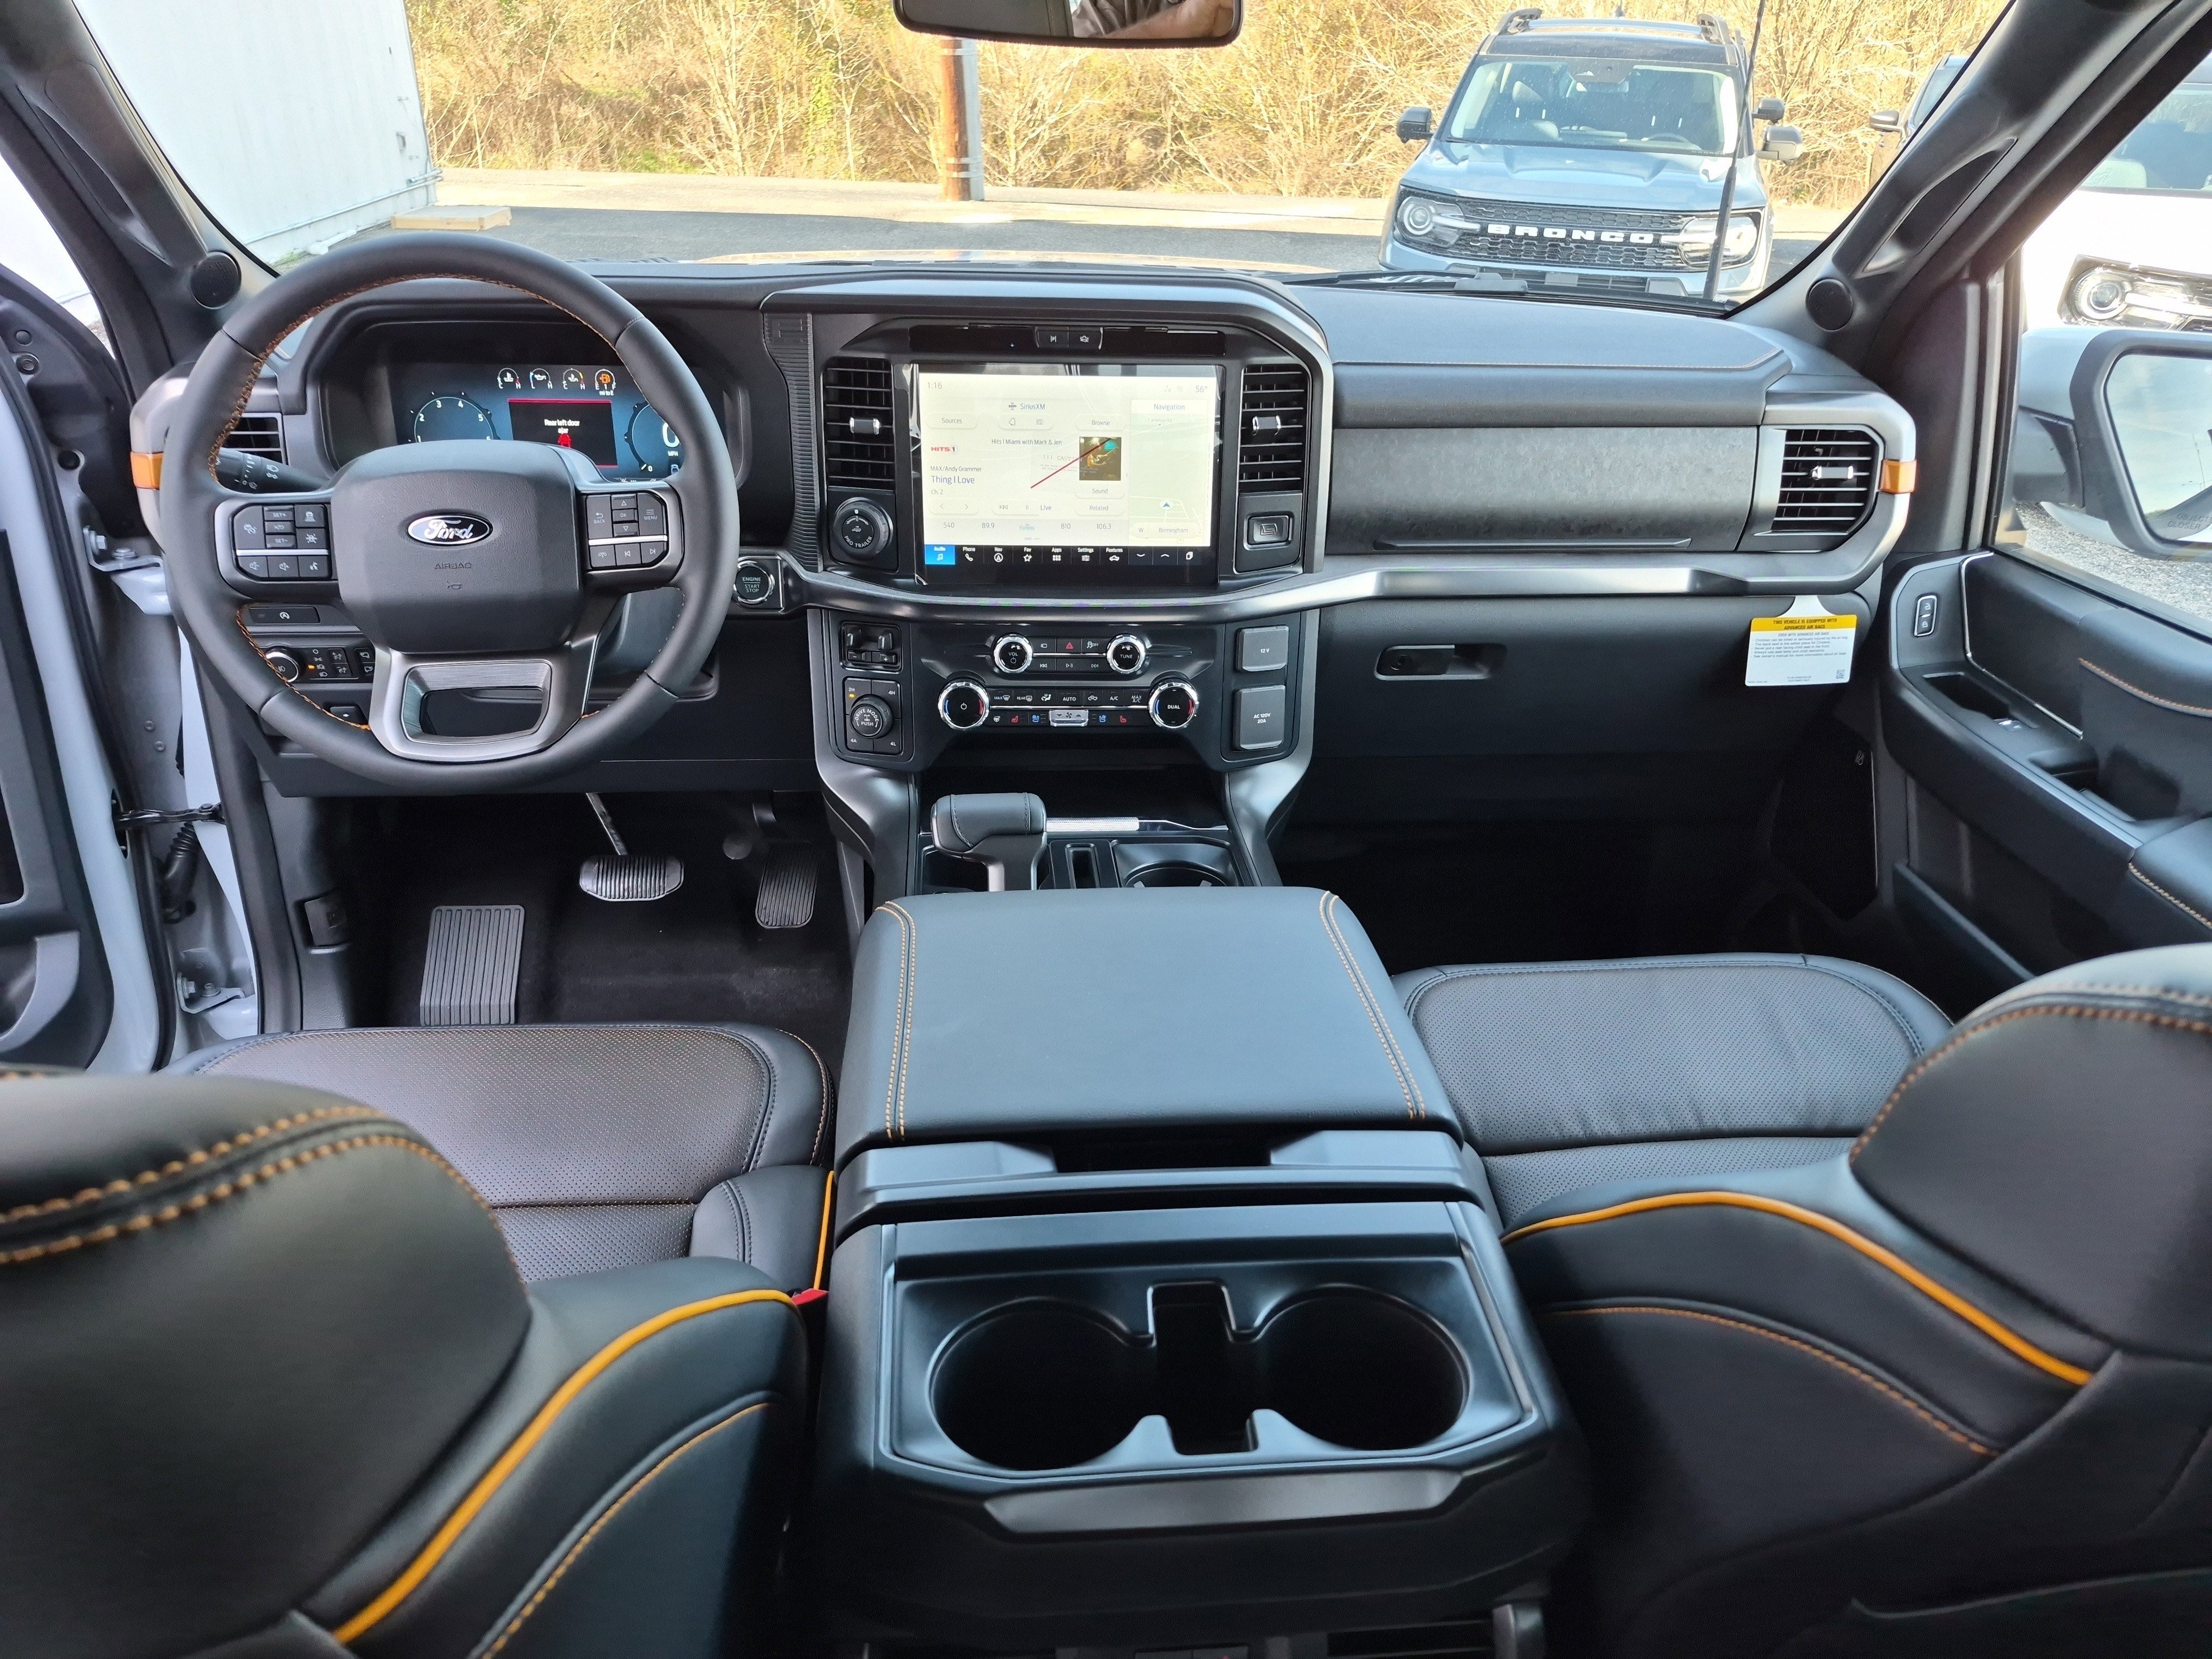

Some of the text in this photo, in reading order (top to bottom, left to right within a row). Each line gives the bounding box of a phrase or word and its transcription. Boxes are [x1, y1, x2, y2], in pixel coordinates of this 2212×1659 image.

[1487, 223, 1654, 244] BRONCO
[436, 400, 442, 408] 3
[458, 400, 464, 408] 4
[419, 414, 425, 422] 2
[478, 414, 484, 422] 5
[931, 475, 952, 485] Thing
[424, 519, 474, 539] Ford
[844, 536, 872, 548] PRO TRAILER
[854, 708, 879, 722] DRIVE MODE
